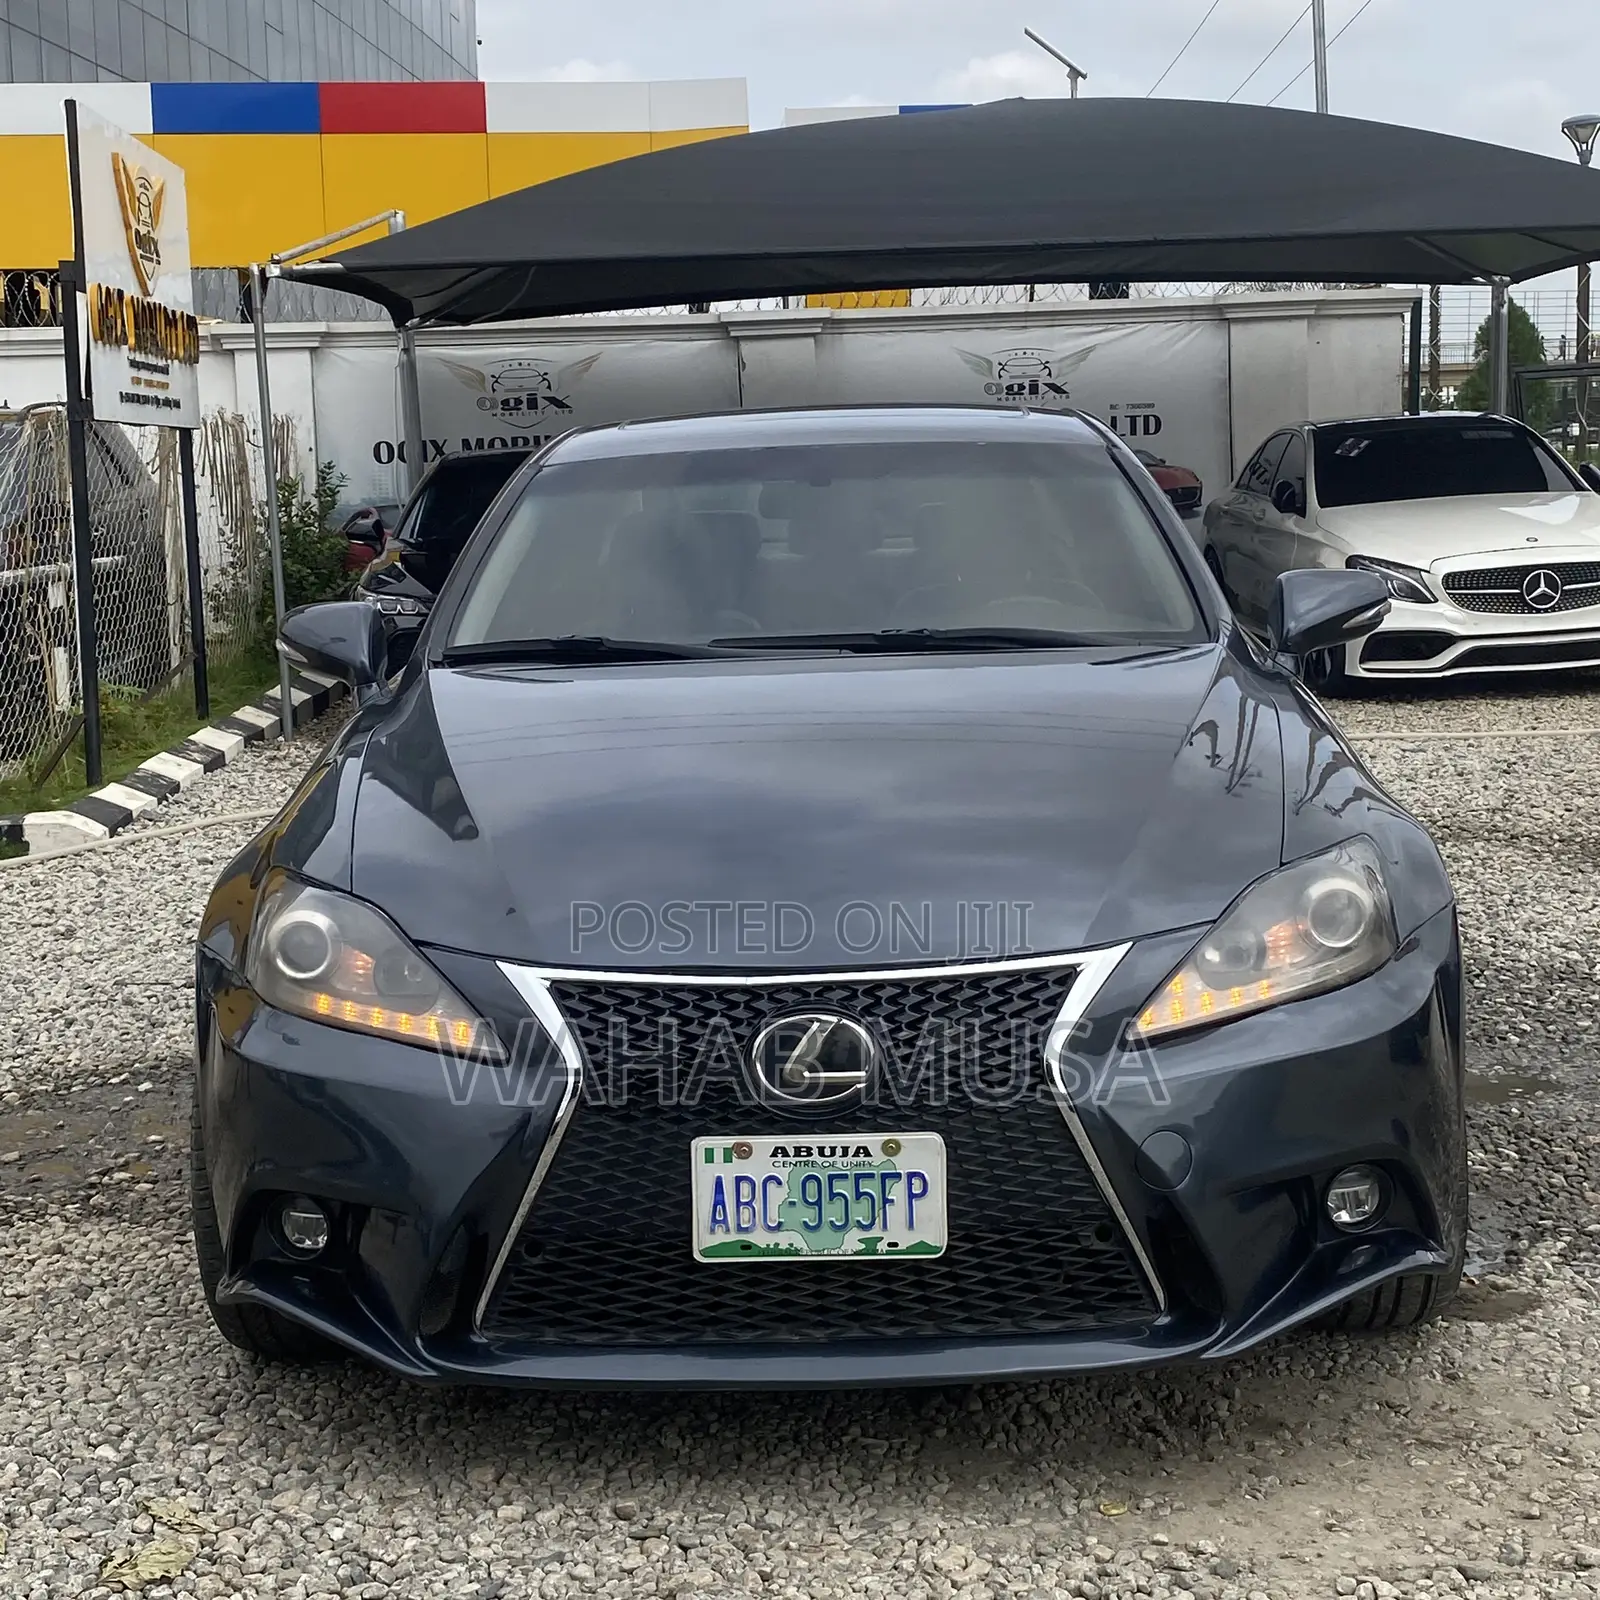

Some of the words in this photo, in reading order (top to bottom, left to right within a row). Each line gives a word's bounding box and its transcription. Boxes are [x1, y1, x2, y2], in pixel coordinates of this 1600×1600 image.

[1109, 414, 1162, 437] LTD
[768, 1145, 874, 1159] ABUJA
[771, 1160, 818, 1169] CENTRE
[821, 1160, 838, 1169] OF
[841, 1160, 875, 1169] UNITY
[708, 1170, 930, 1236] ABC-955FP
